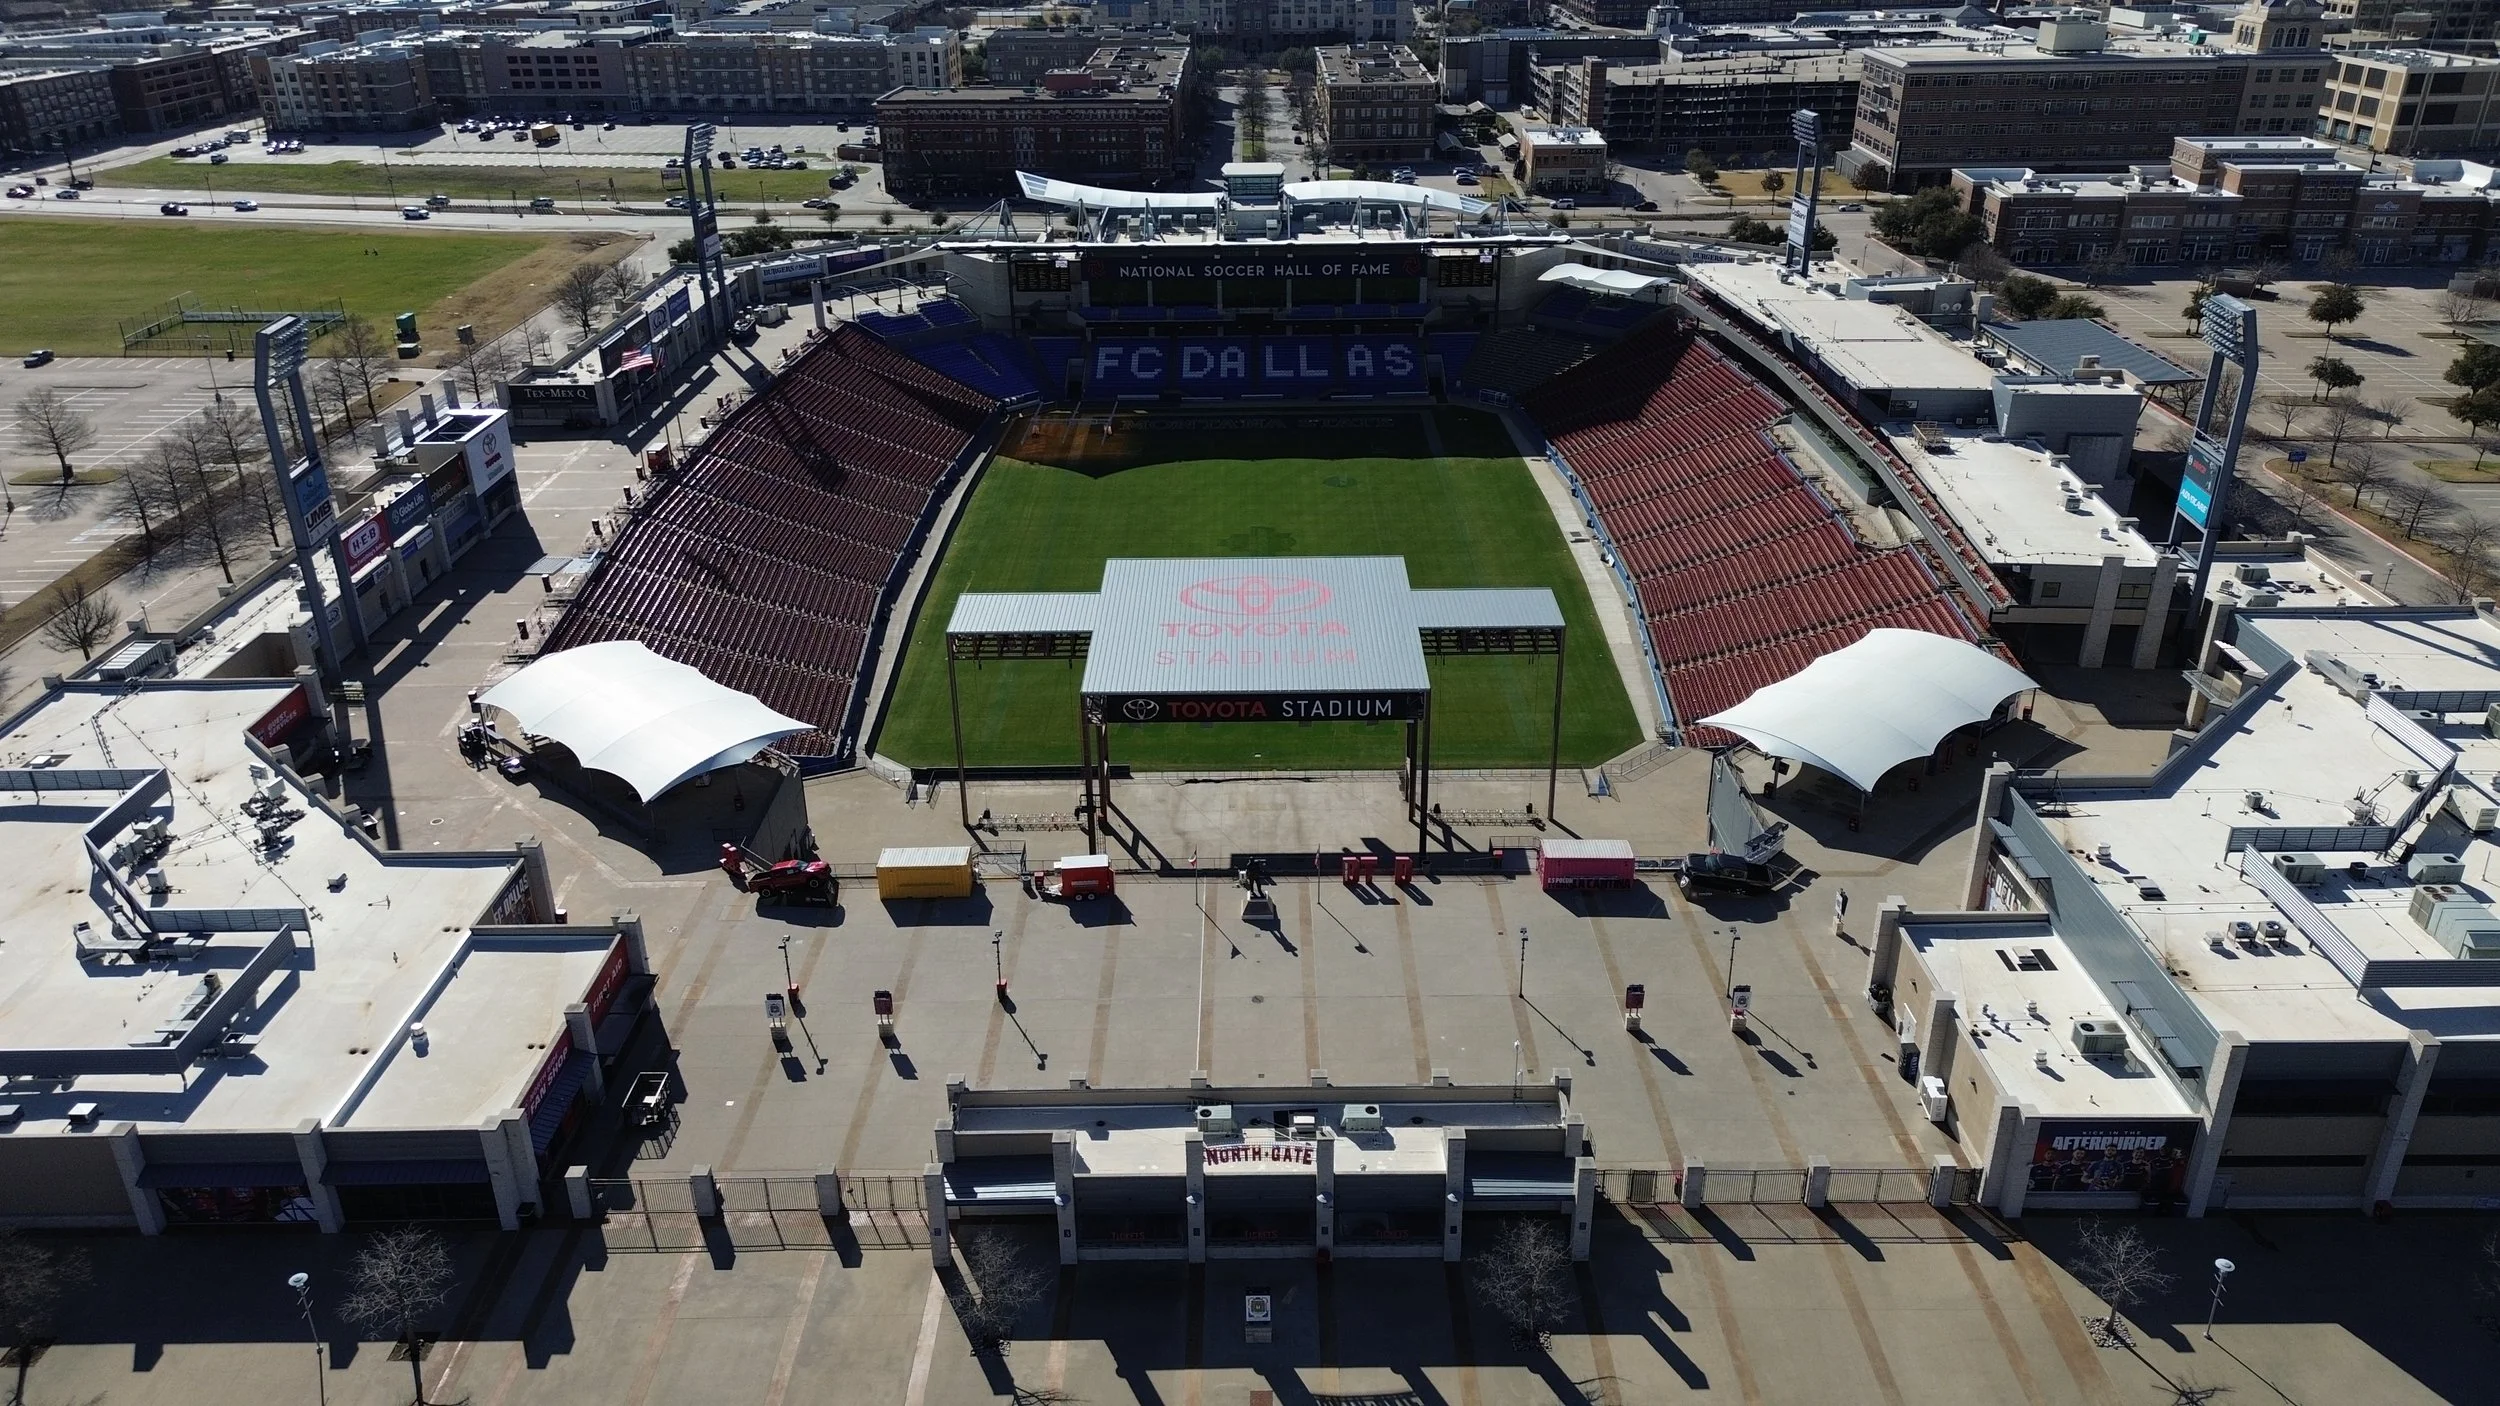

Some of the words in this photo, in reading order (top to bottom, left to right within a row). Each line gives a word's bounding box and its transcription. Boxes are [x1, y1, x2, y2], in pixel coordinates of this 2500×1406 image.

[763, 265, 794, 277] BURGERS
[799, 262, 818, 273] MORE
[1120, 265, 1195, 278] NATIONAL
[1204, 265, 1265, 277] SOCCER
[1274, 264, 1312, 276] HALL
[1322, 264, 1342, 275] OF
[1351, 263, 1390, 275] FAME
[1096, 346, 1163, 379] FC
[1182, 344, 1414, 378] DALLAS
[577, 388, 590, 400] Q
[306, 499, 331, 529] UMB
[1160, 620, 1350, 638] TOYOTA
[1156, 648, 1357, 666] STADIUM
[1167, 701, 1267, 718] TOYOTA
[1282, 700, 1393, 717] STADIUM
[593, 977, 611, 1013] FIRST
[611, 958, 623, 982] AID
[530, 1083, 547, 1115] FAN
[547, 1046, 568, 1086] SHOP
[1206, 1147, 1262, 1166] NORTH
[1272, 1145, 1314, 1165] GATE
